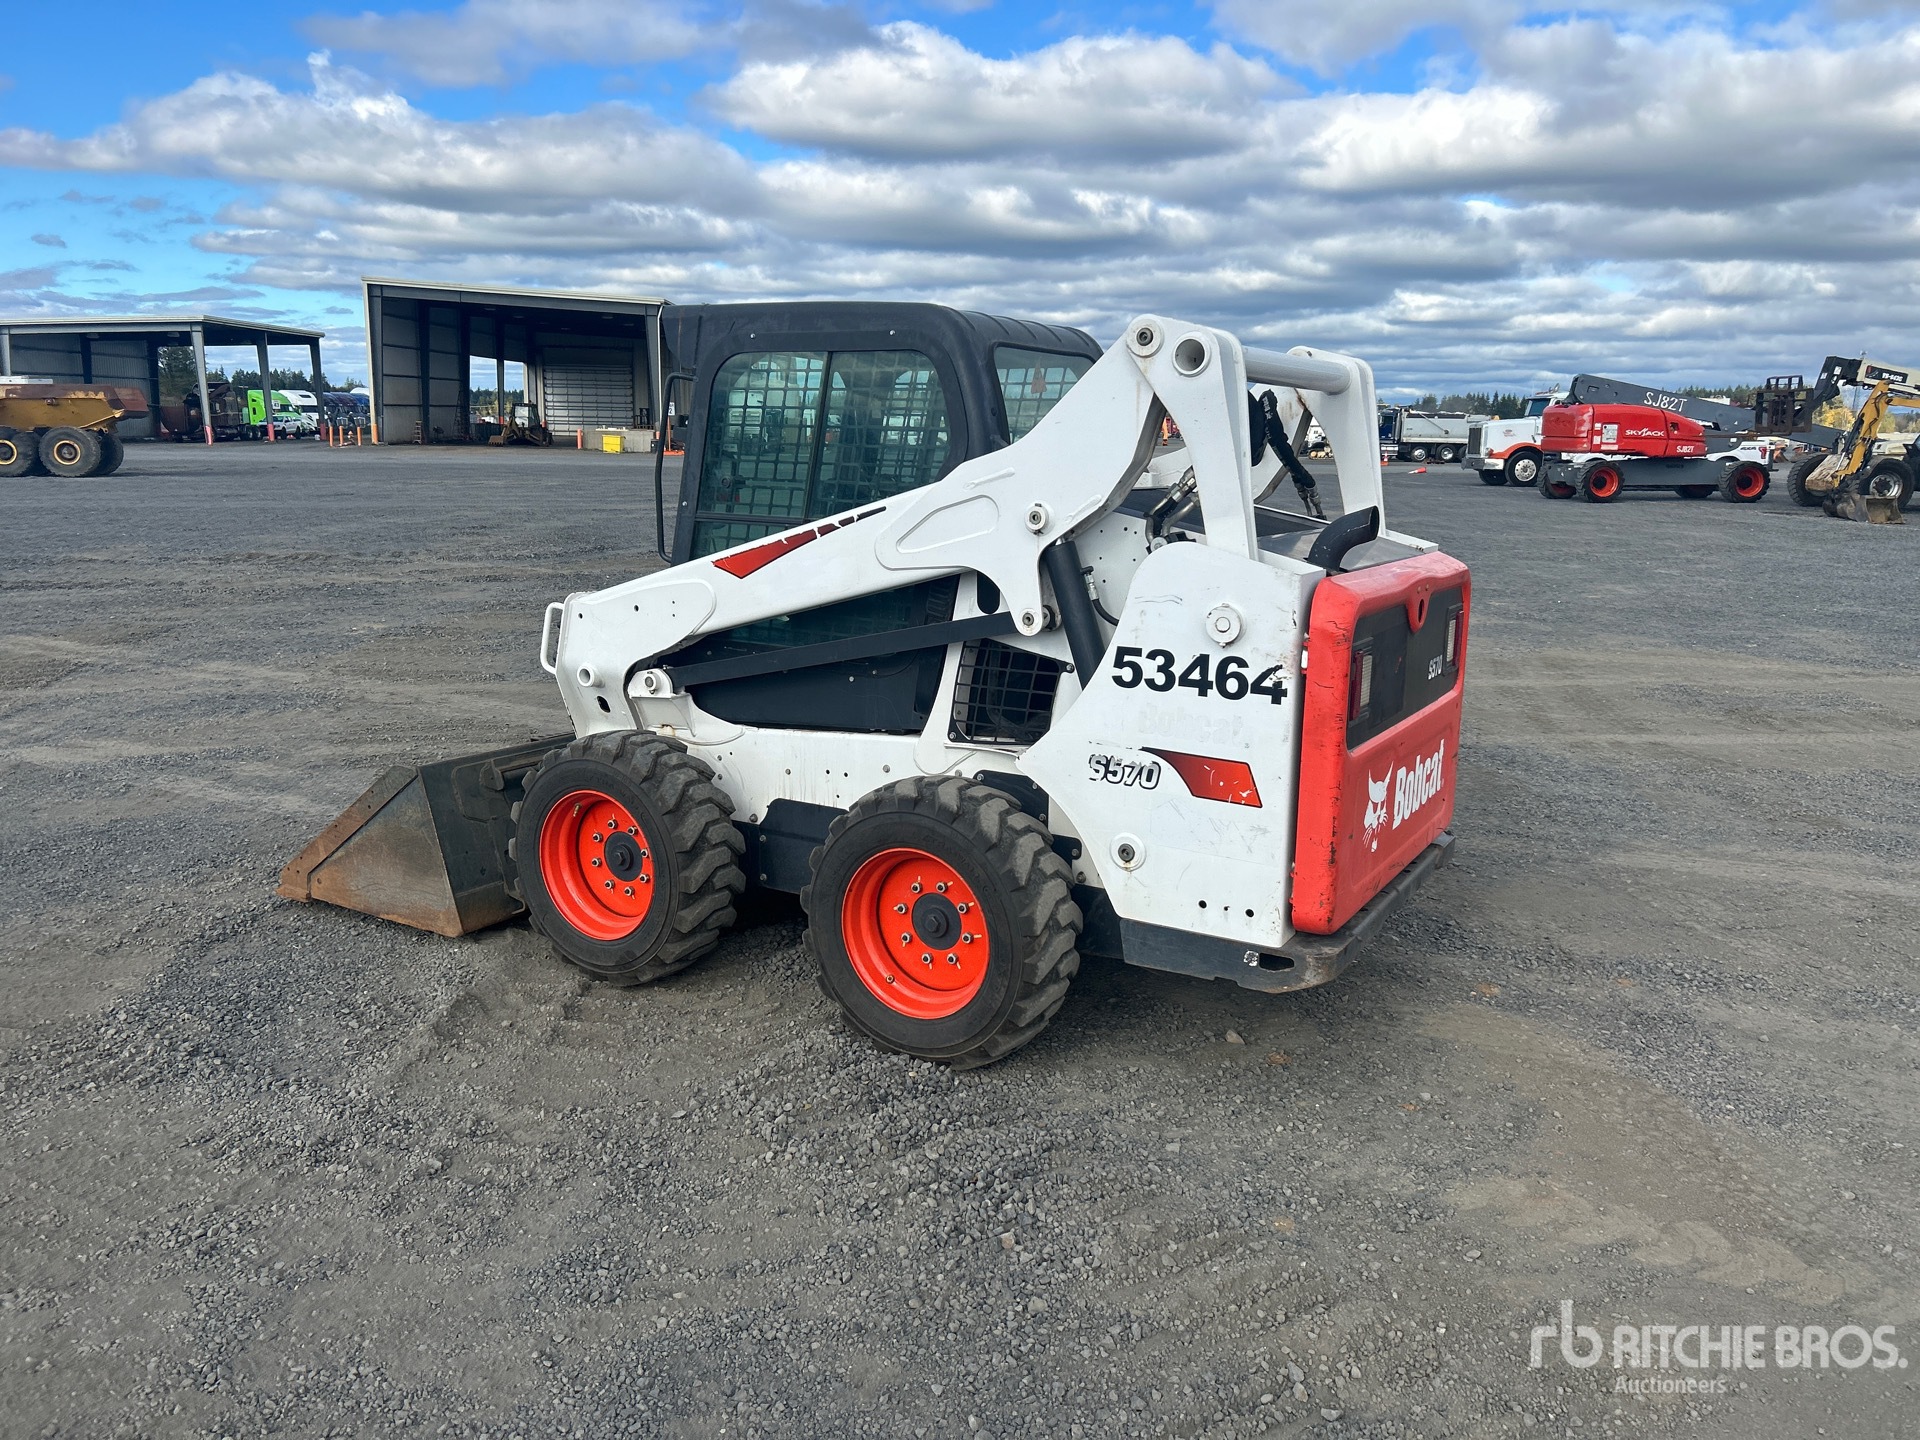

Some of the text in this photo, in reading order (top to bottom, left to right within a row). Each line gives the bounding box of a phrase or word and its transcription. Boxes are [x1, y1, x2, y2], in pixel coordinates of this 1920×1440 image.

[1644, 391, 1688, 412] SJ82T
[1625, 427, 1665, 437] SKYJACK
[1676, 445, 1695, 453] SJ82T
[1112, 645, 1288, 706] 53464
[1427, 654, 1443, 680] S570
[1088, 754, 1162, 790] S570
[1392, 738, 1445, 830] Bobcat
